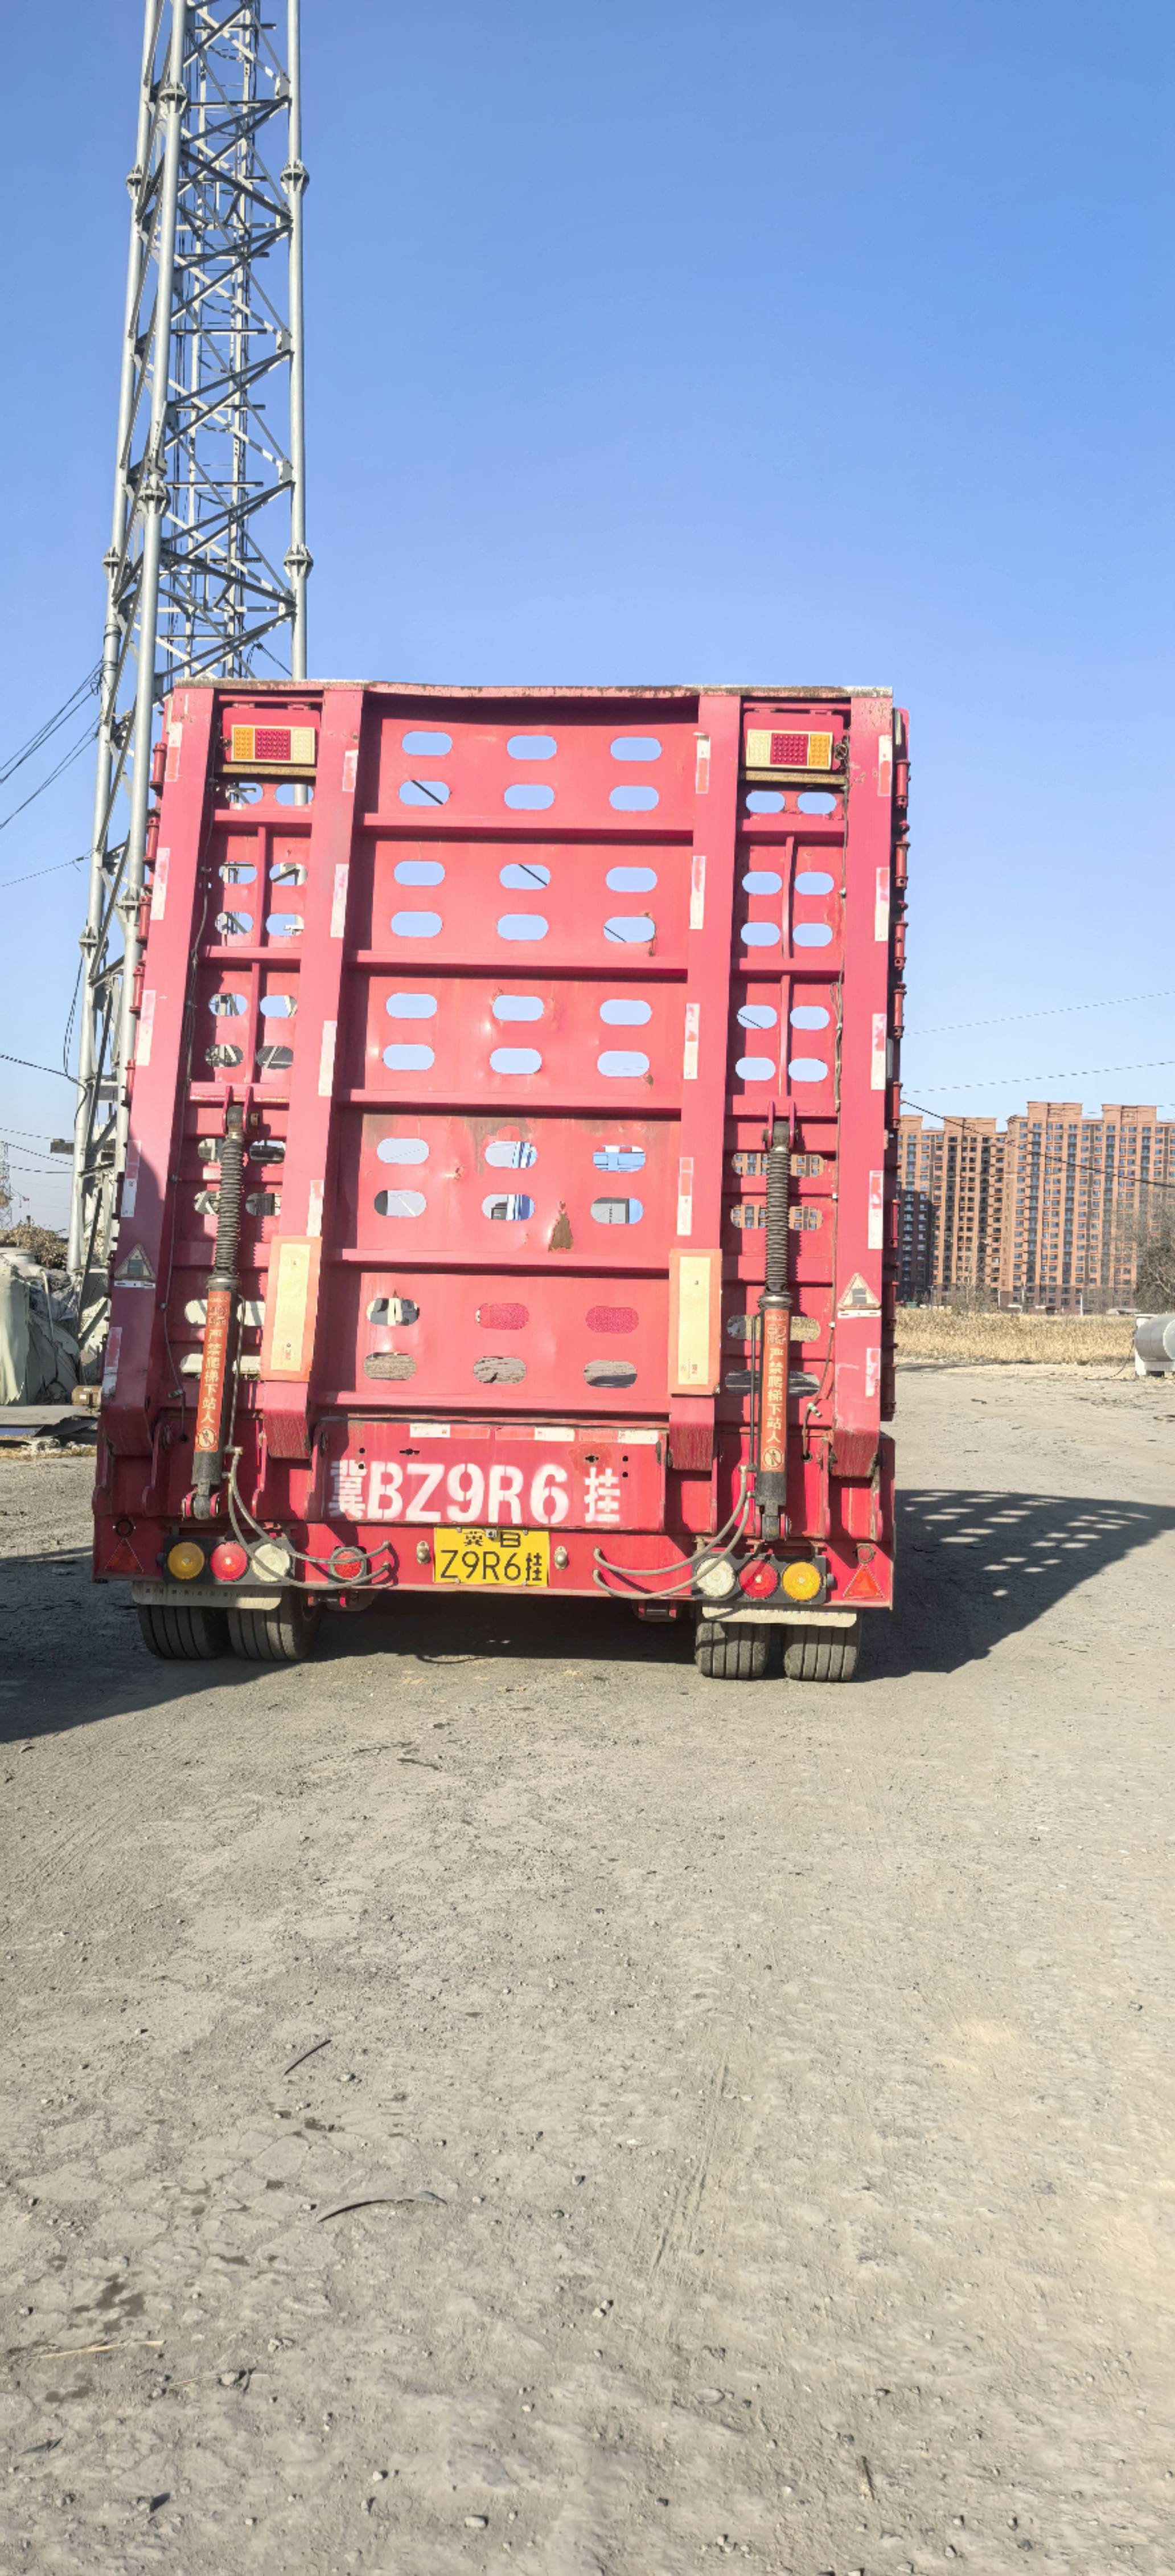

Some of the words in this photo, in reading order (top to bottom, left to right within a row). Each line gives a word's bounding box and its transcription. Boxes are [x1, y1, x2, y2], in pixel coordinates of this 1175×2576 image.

[200, 1329, 224, 1424] 严禁爬梯下站人
[766, 1347, 784, 1443] 严禁爬梯下站人
[440, 1549, 542, 1581] Z9R6挂
